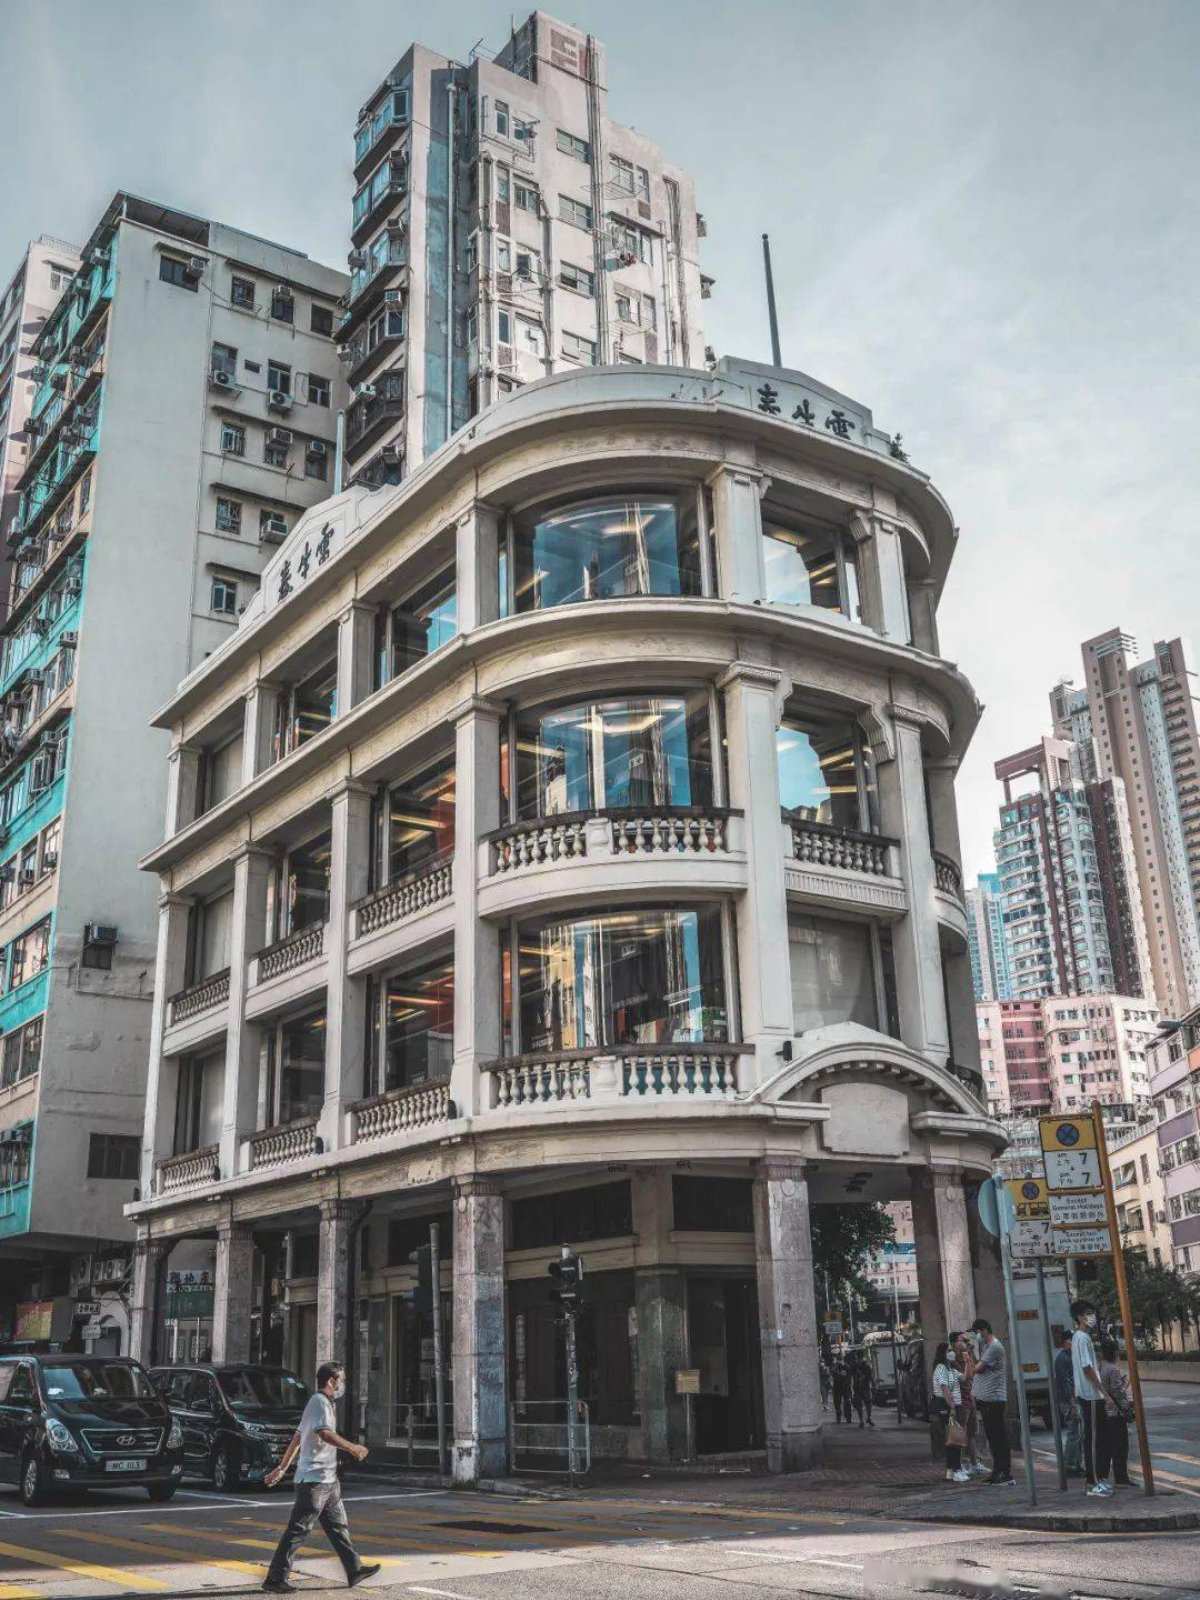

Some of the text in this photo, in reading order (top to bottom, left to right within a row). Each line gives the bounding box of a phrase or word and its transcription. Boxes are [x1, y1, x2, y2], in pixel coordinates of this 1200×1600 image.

[1079, 1152, 1087, 1164] 7
[1081, 1172, 1090, 1184] 7
[1041, 1222, 1049, 1234] 7
